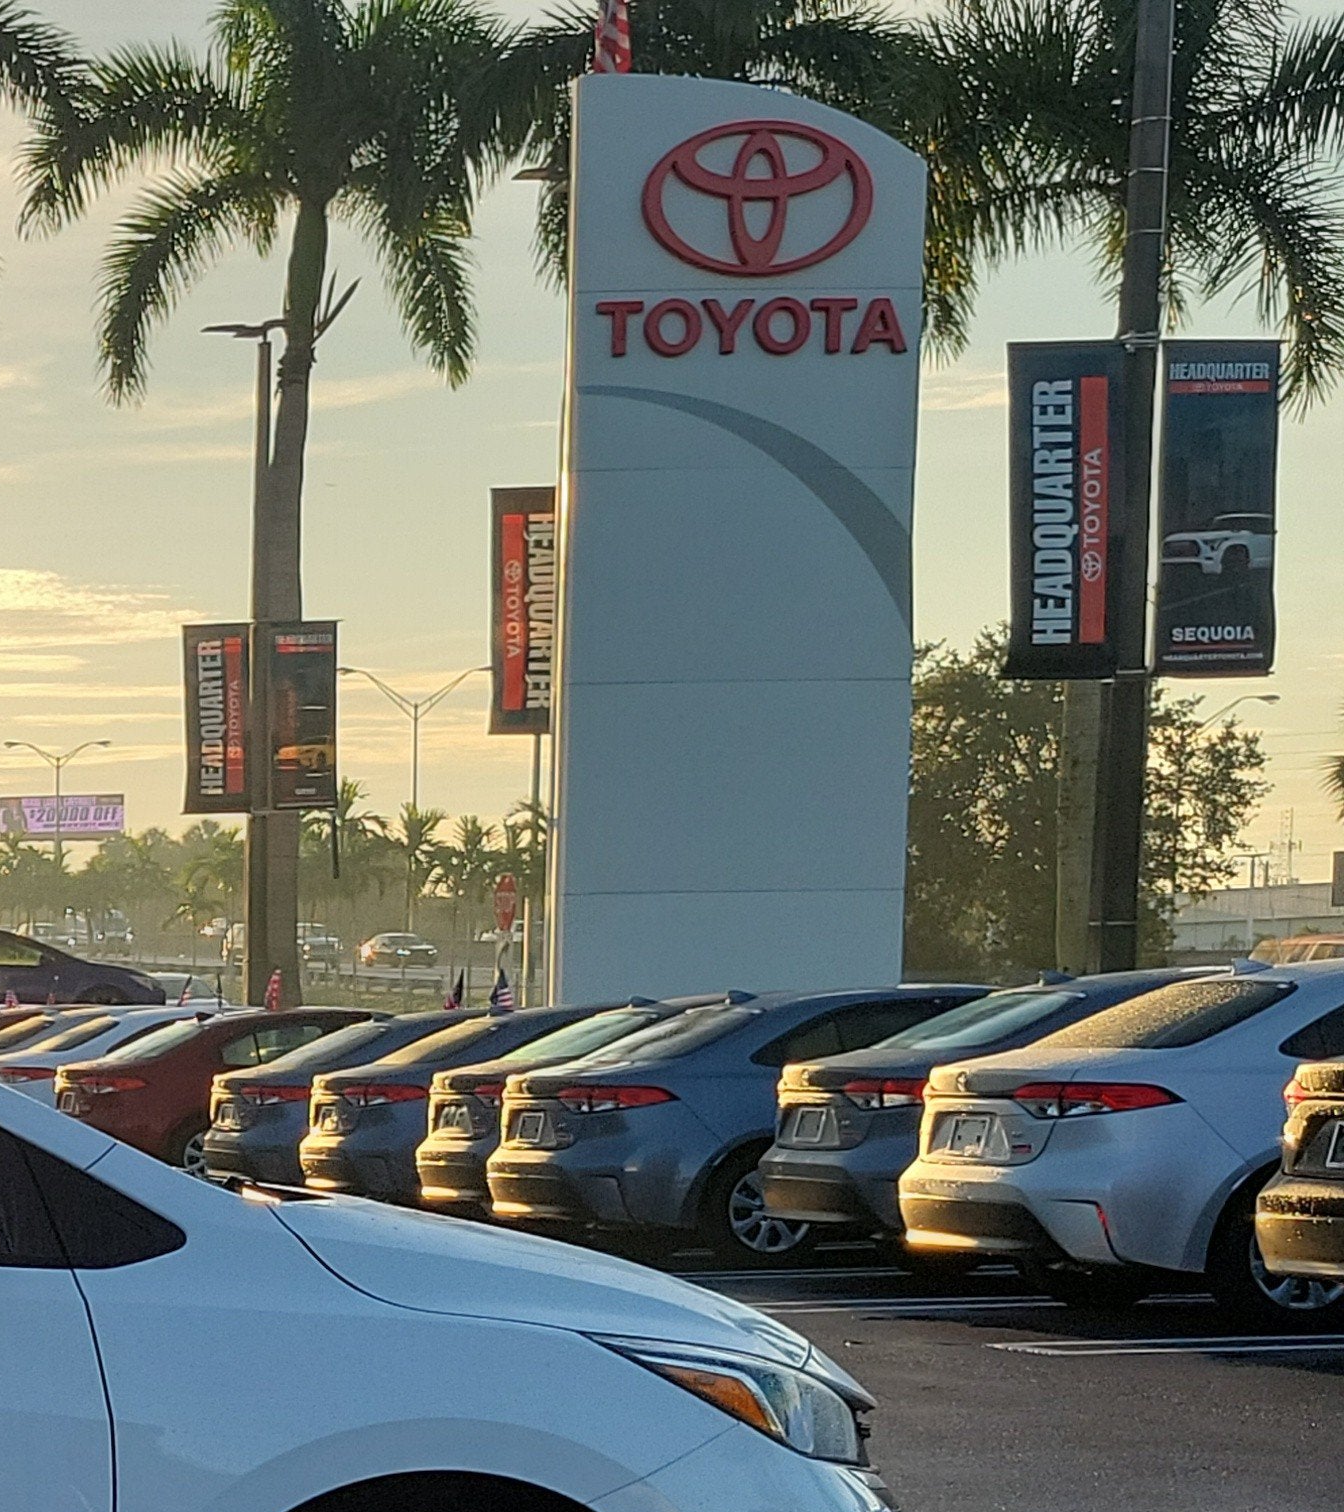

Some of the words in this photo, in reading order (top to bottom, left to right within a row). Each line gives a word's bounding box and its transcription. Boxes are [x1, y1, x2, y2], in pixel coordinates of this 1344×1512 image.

[596, 297, 908, 358] TOYOTA
[1170, 362, 1270, 382] HEADQUARTER
[1207, 382, 1244, 393] TOYOTA
[1031, 379, 1079, 645] HEADQUARTER
[1082, 447, 1103, 550] TOYOTA
[505, 585, 521, 658] TOYOTA
[1172, 625, 1255, 643] SEQUOIA
[197, 640, 227, 795] HEADQUARTER
[228, 680, 241, 741] TOYOTA
[93, 806, 118, 821] OFF
